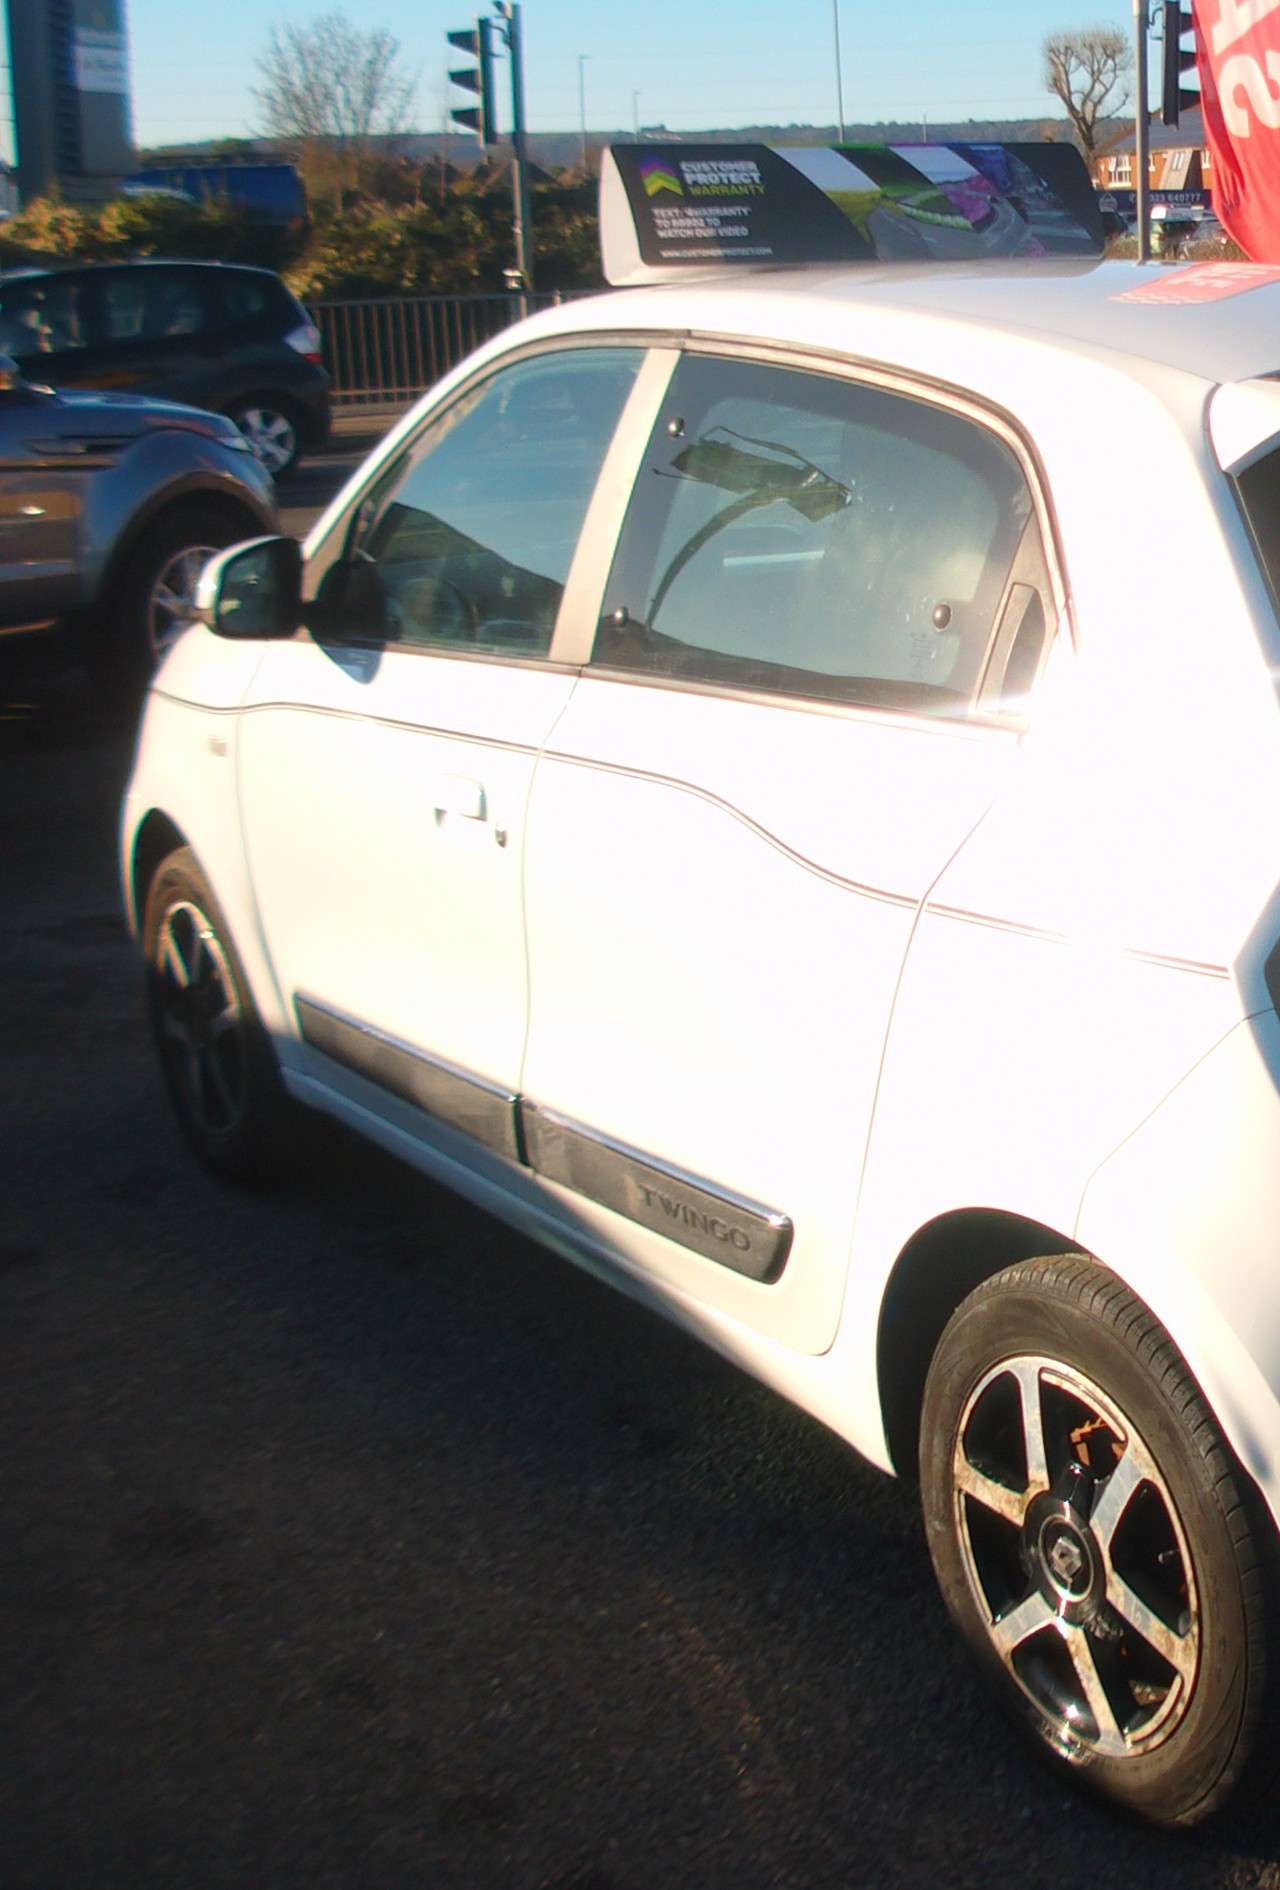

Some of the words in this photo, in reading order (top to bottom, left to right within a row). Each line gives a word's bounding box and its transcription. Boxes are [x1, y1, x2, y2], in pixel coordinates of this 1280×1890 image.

[680, 160, 759, 173] CUSTOMER
[683, 172, 761, 185] PROTECT
[688, 184, 765, 196] WARRANTY
[717, 225, 749, 237] VIDEO
[637, 1182, 751, 1251] TWINGO
